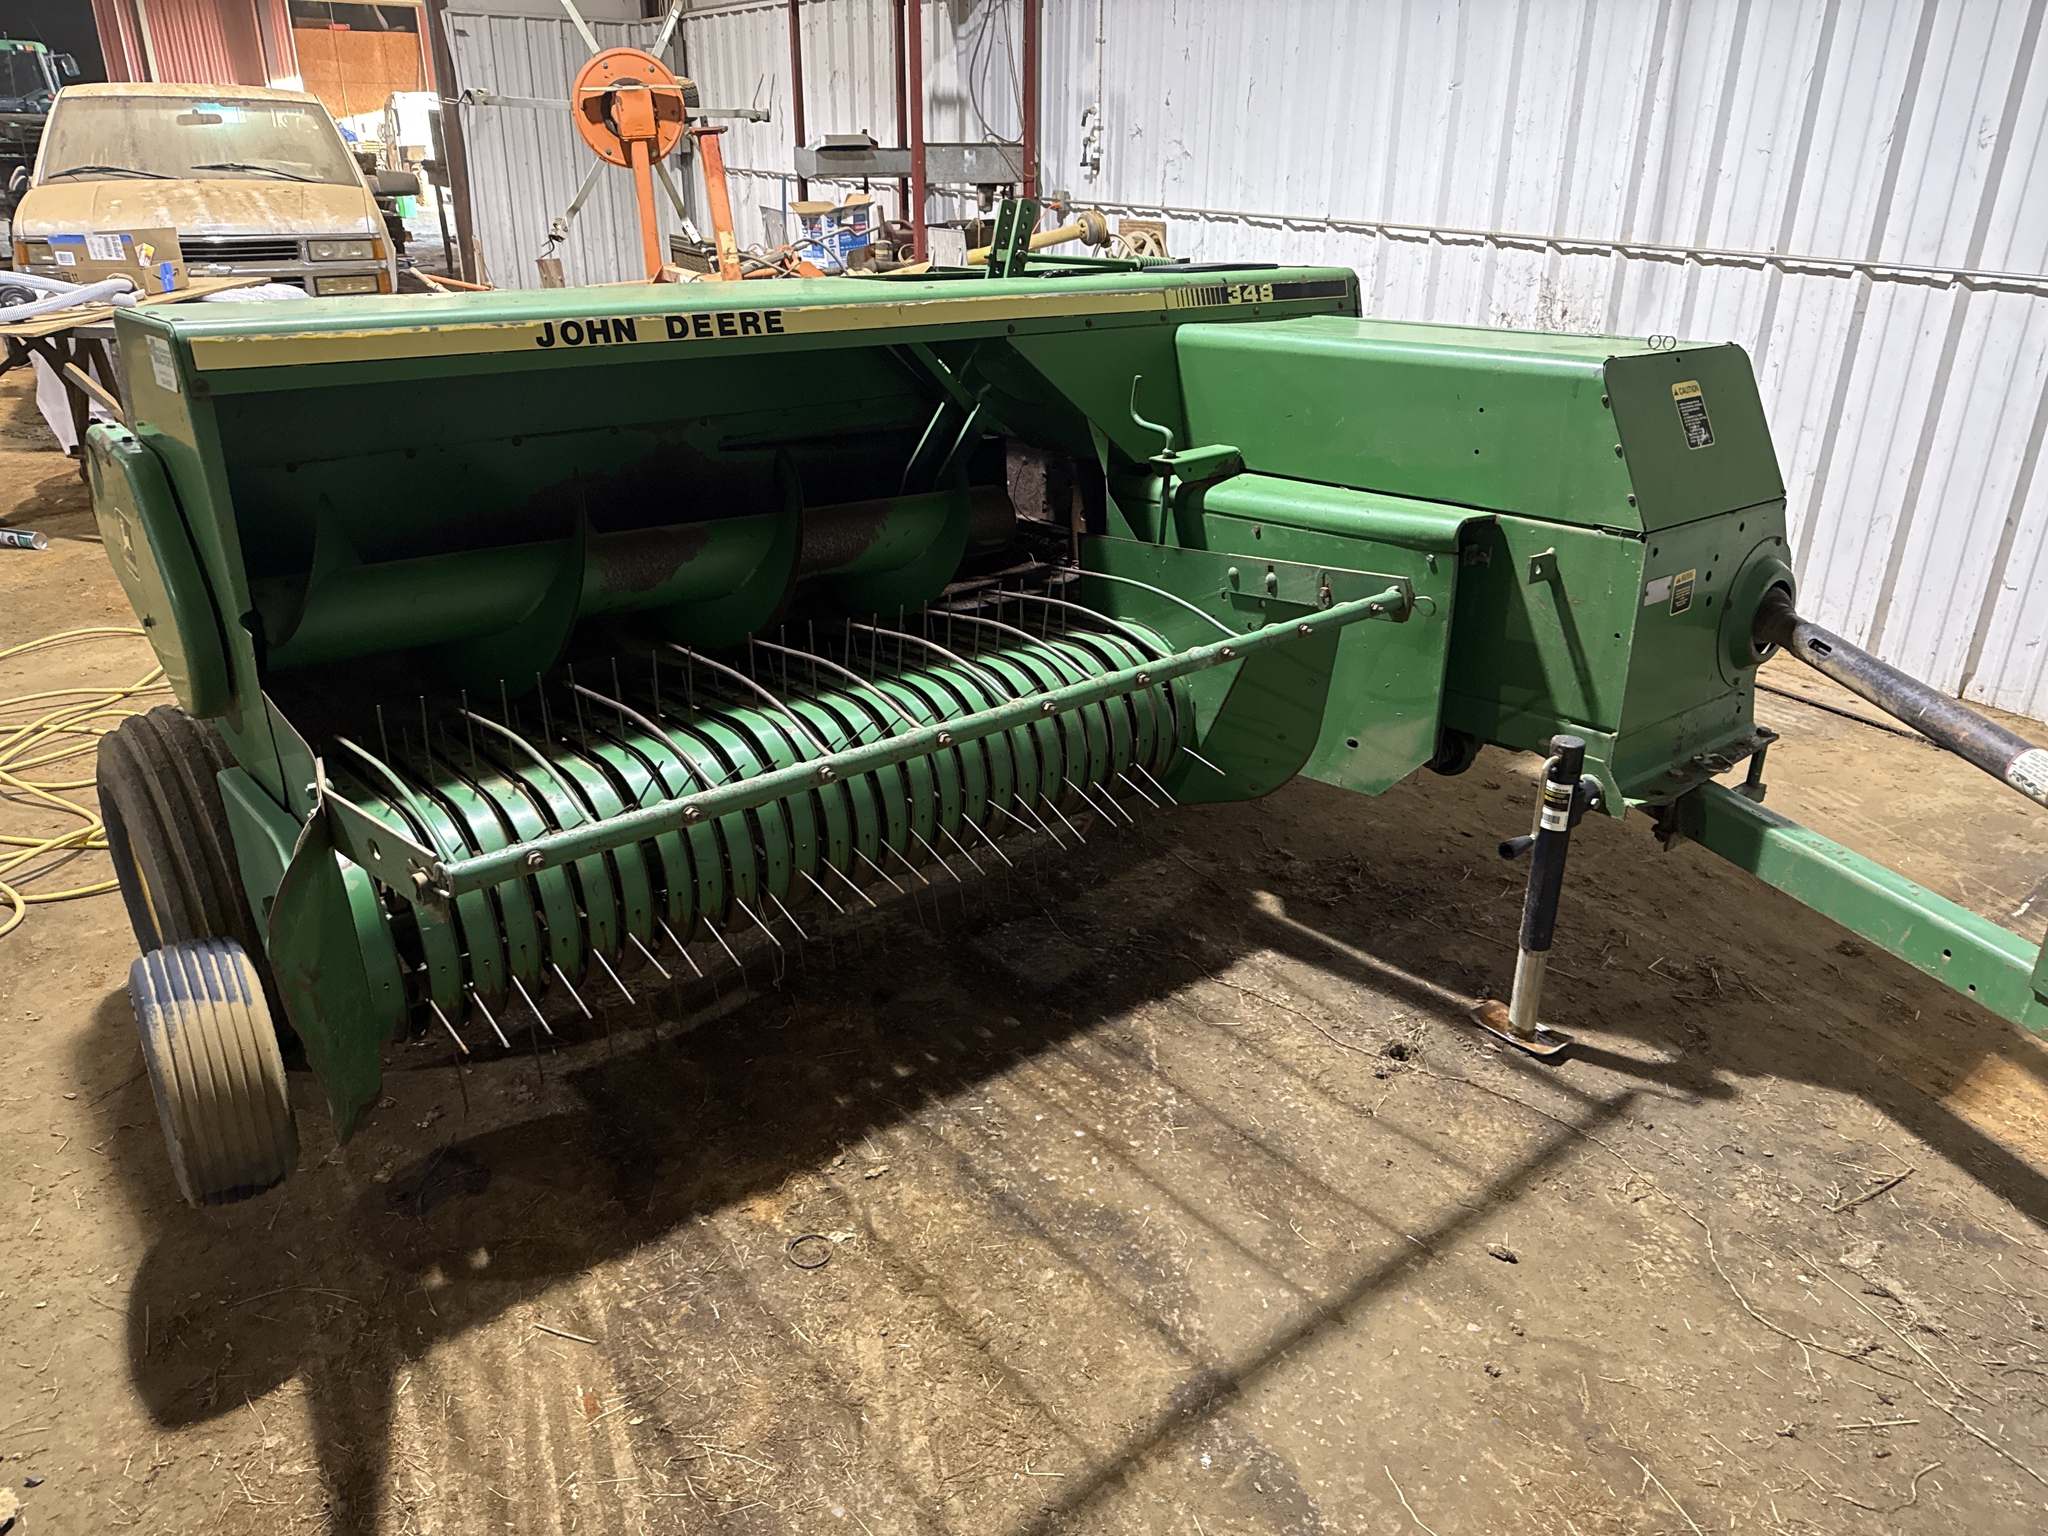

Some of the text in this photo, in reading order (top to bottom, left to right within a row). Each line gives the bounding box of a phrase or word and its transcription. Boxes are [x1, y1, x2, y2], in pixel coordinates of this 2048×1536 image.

[1227, 284, 1273, 304] 348
[536, 311, 784, 347] JOHN DEERE
[1679, 385, 1699, 395] CAUTION
